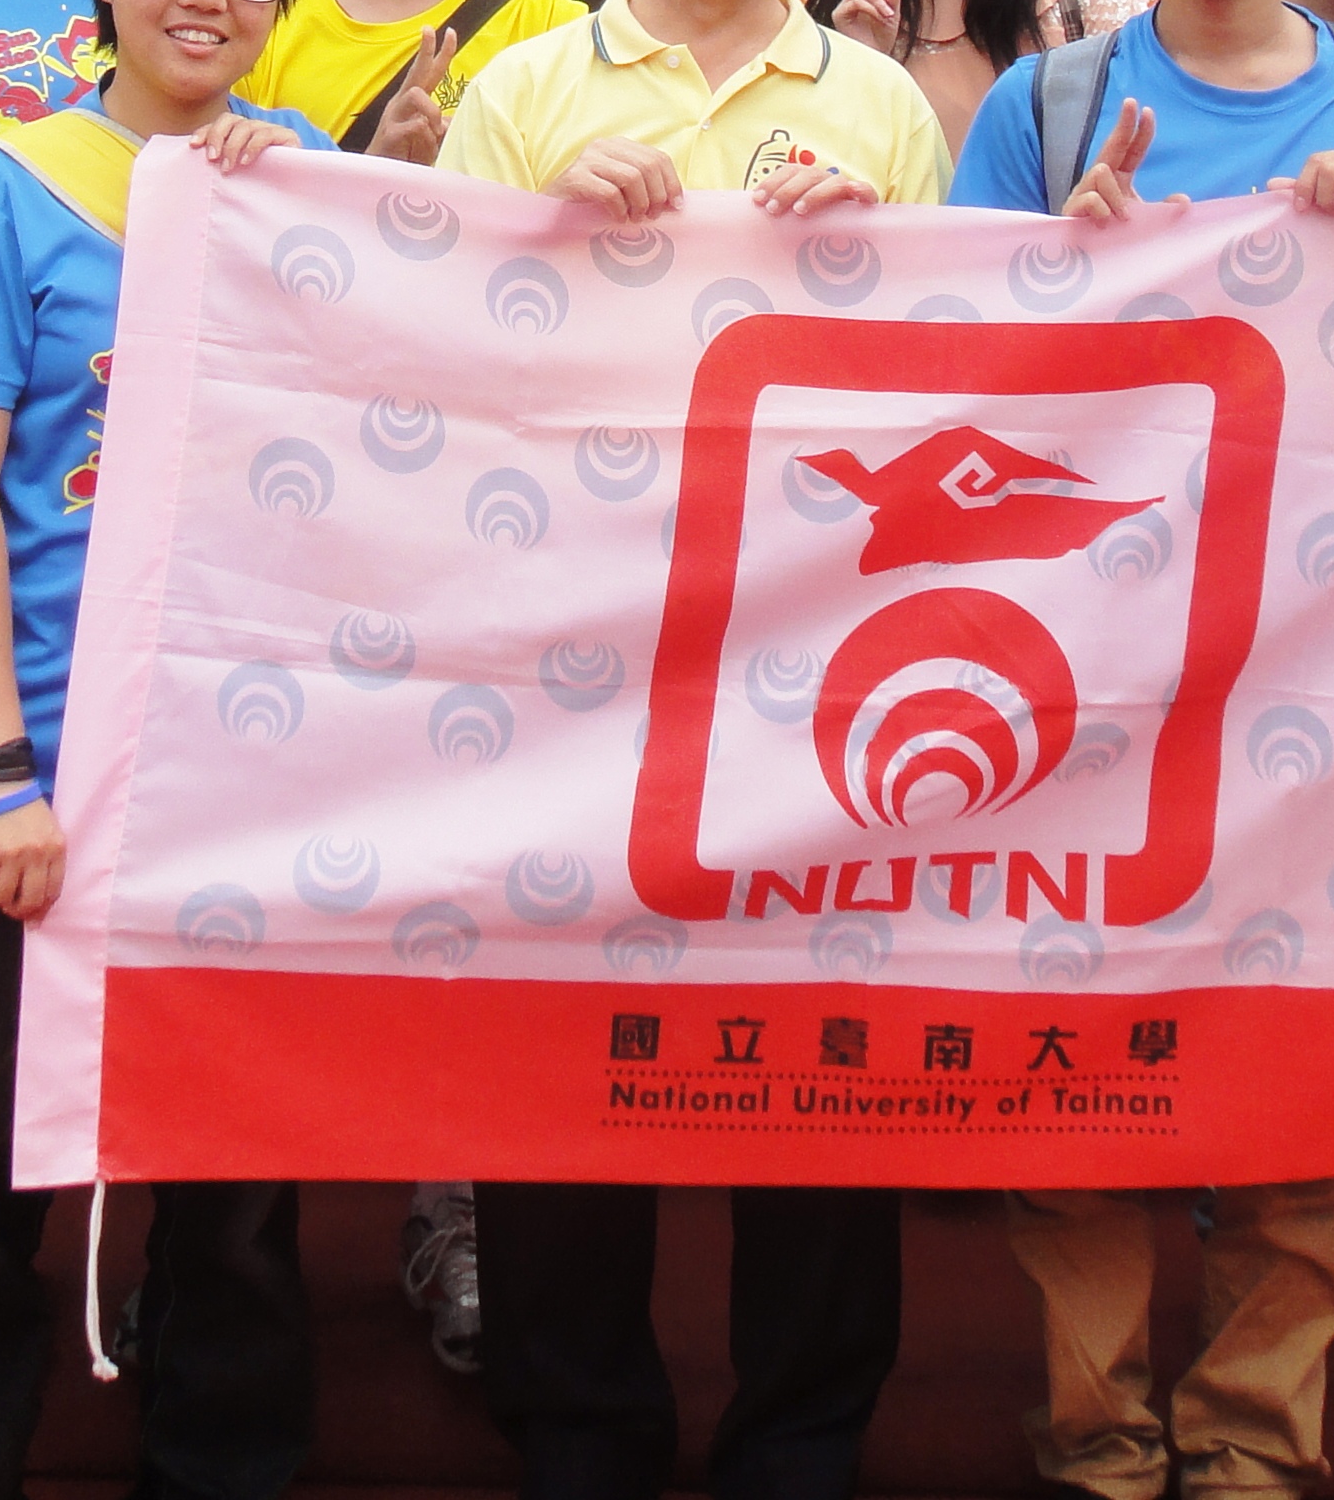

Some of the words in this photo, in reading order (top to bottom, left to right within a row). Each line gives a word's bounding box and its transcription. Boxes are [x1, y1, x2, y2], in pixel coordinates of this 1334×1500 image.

[744, 851, 1088, 924] NUTN
[609, 1013, 1178, 1072] 國立臺南大學
[609, 1082, 770, 1113] National
[793, 1084, 976, 1123] University
[997, 1087, 1032, 1116] of
[1052, 1083, 1173, 1116] Tainan
